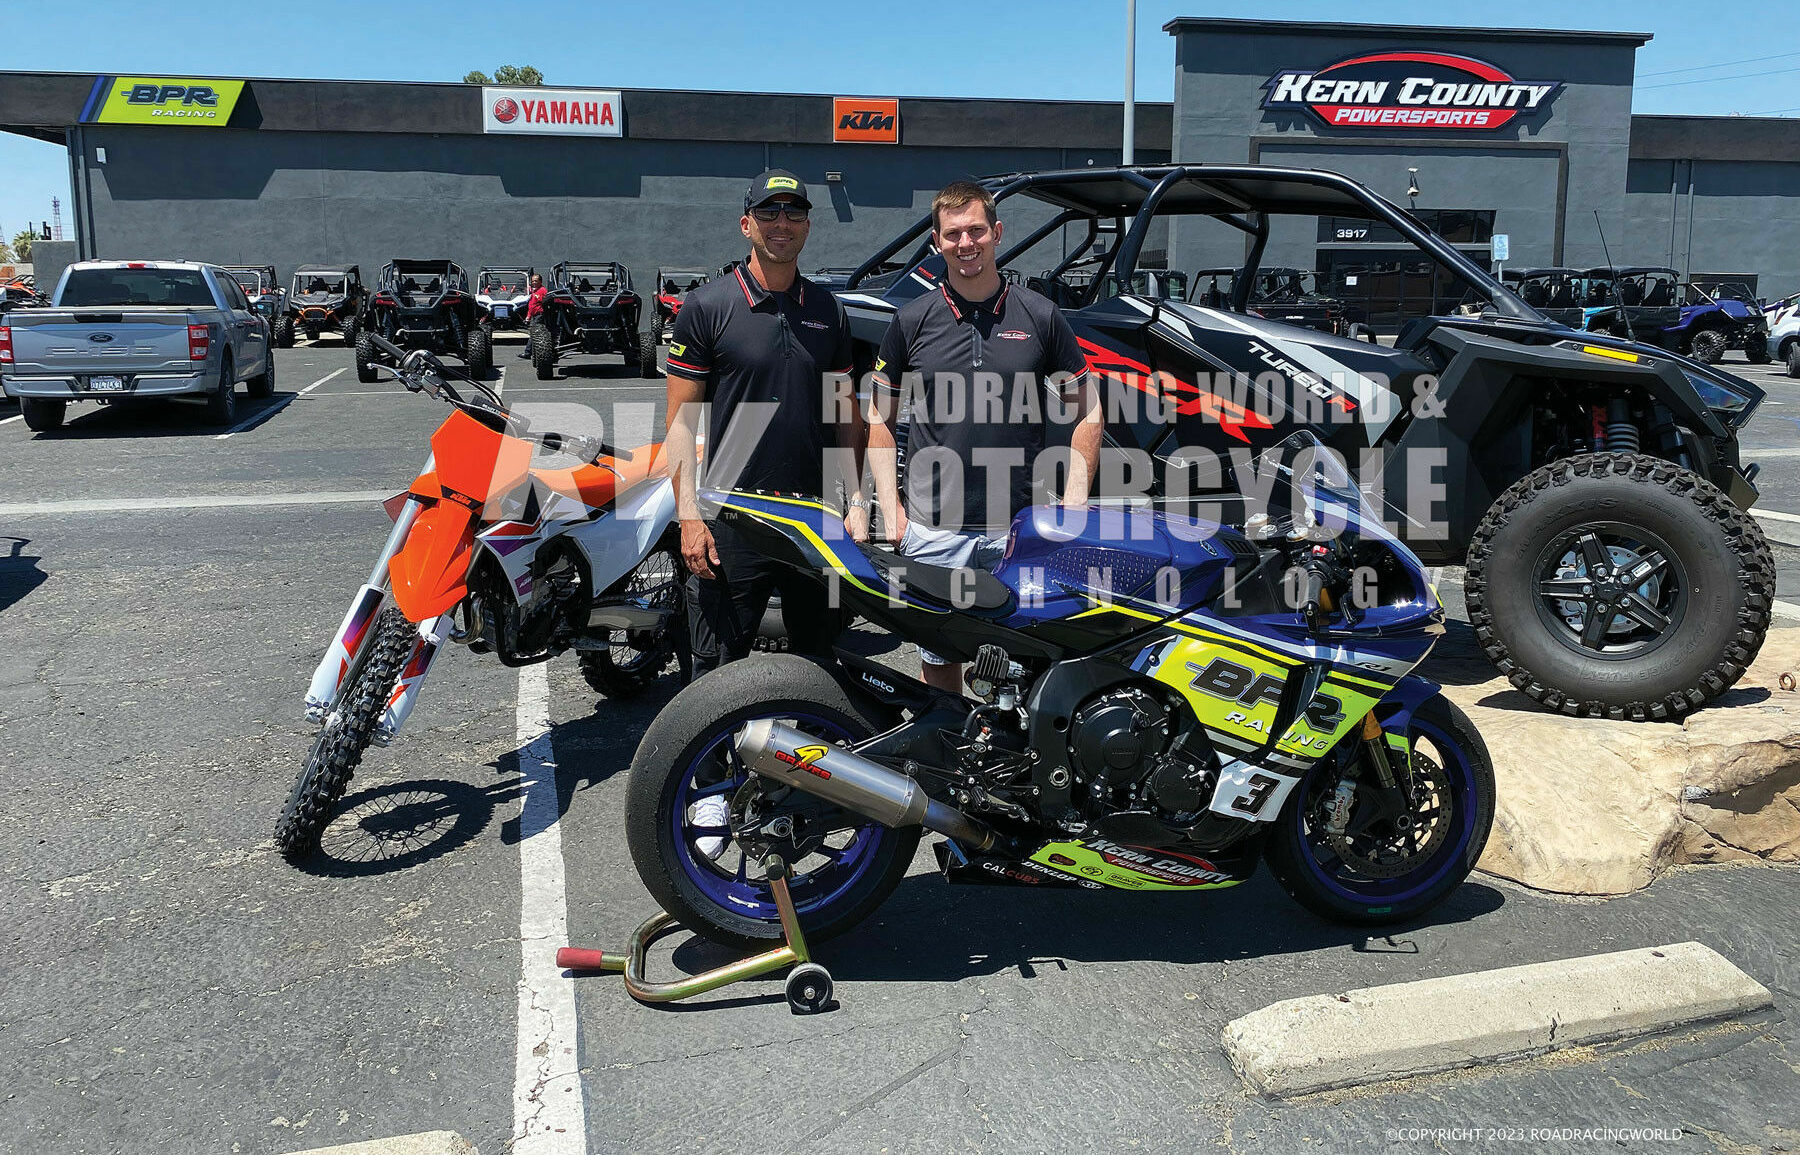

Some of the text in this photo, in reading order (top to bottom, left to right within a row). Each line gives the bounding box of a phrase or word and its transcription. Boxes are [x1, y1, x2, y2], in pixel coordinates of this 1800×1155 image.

[124, 84, 218, 107] BPR
[1270, 74, 1553, 107] KERN COUNTY
[151, 109, 217, 118] RACING
[521, 99, 614, 126] YAMAHA
[839, 110, 895, 130] KTM
[1335, 108, 1490, 125] POWERSPORTS
[1336, 229, 1368, 239] 3917
[1248, 341, 1358, 413] TURBO R
[1187, 656, 1347, 735] BPR
[775, 750, 832, 780] GRAVES
[1231, 773, 1281, 816] 3
[1335, 796, 1346, 822] brembo
[1021, 861, 1077, 881] DUNLOP
[1087, 839, 1153, 864] KERN
[1151, 859, 1233, 882] COUNTY
[1111, 858, 1193, 883] POWERSPORTS
